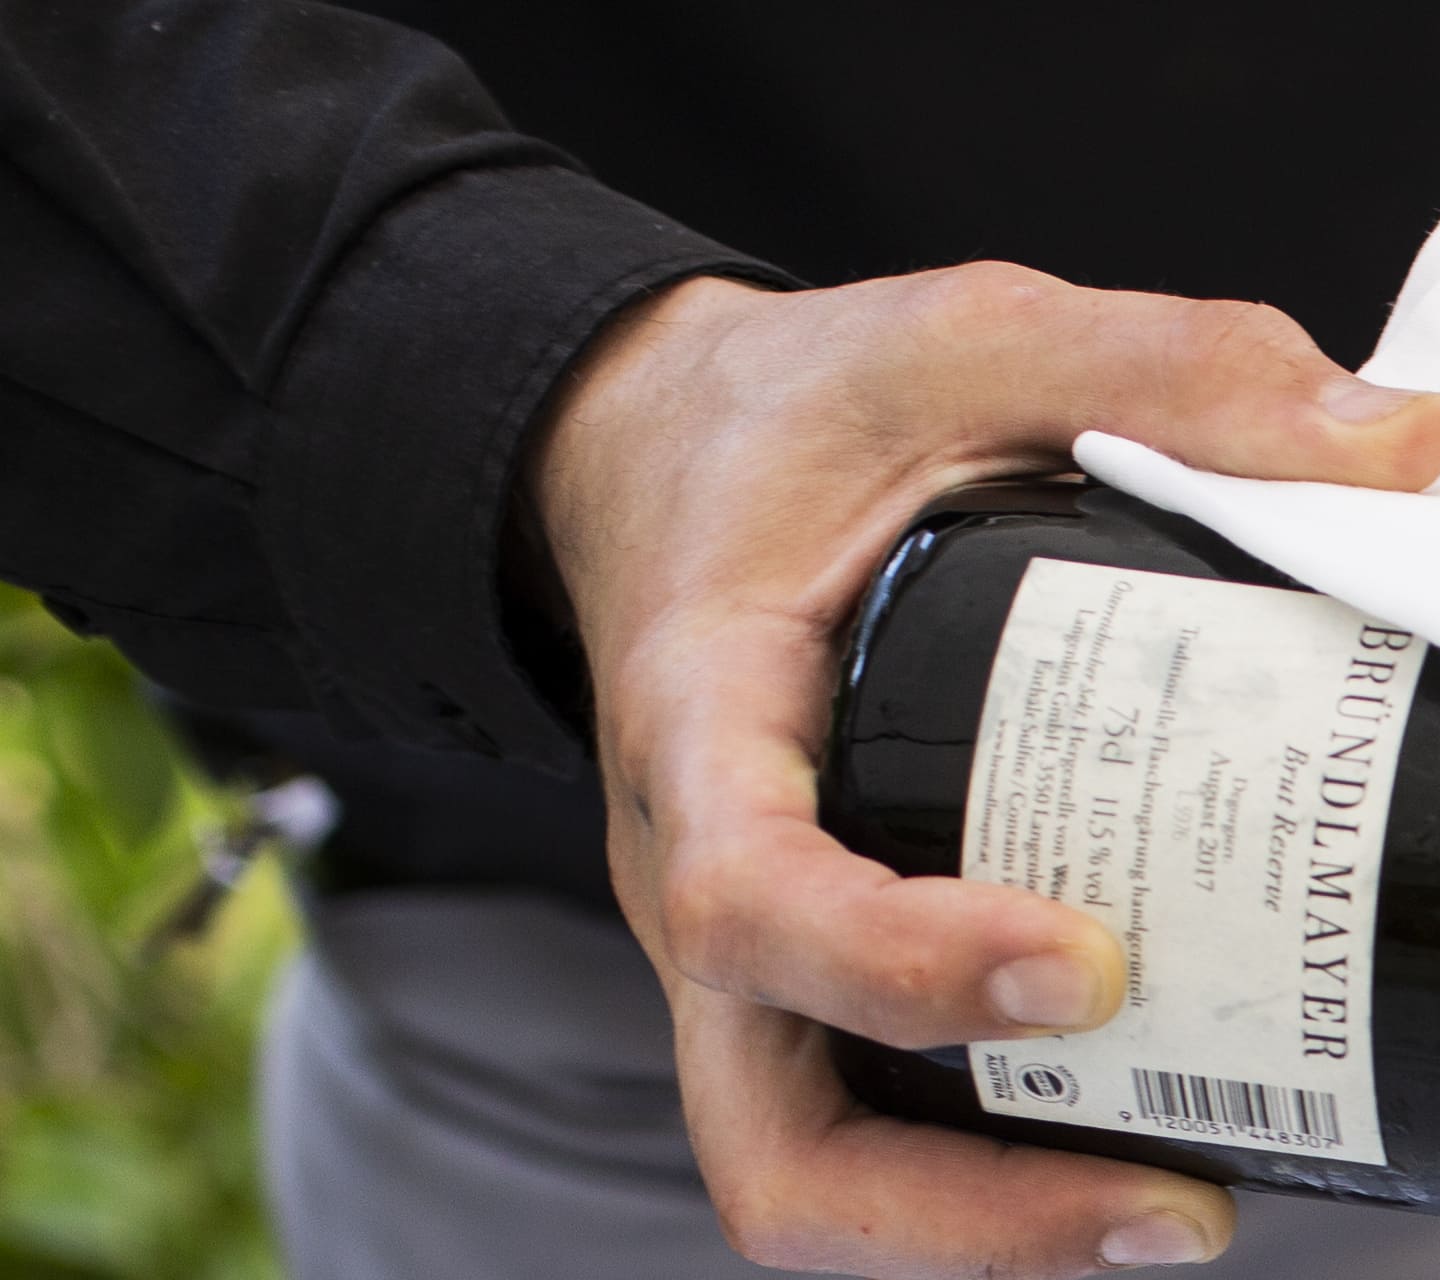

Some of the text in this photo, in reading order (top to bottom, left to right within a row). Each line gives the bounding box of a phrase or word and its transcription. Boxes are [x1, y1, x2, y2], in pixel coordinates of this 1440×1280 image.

[1057, 726, 1088, 818] Hergestellt
[1124, 627, 1201, 1007] Traditionelle Flaschengärung handgerüttelt
[1002, 791, 1026, 871] Contains
[1024, 809, 1049, 890] Langenlo
[1053, 825, 1067, 856] von
[1194, 750, 1231, 892] August 2017
[1264, 744, 1309, 913] Brut Reserve
[1302, 624, 1413, 1059] BRÜNDLMAYER
[1083, 871, 1113, 907] vol
